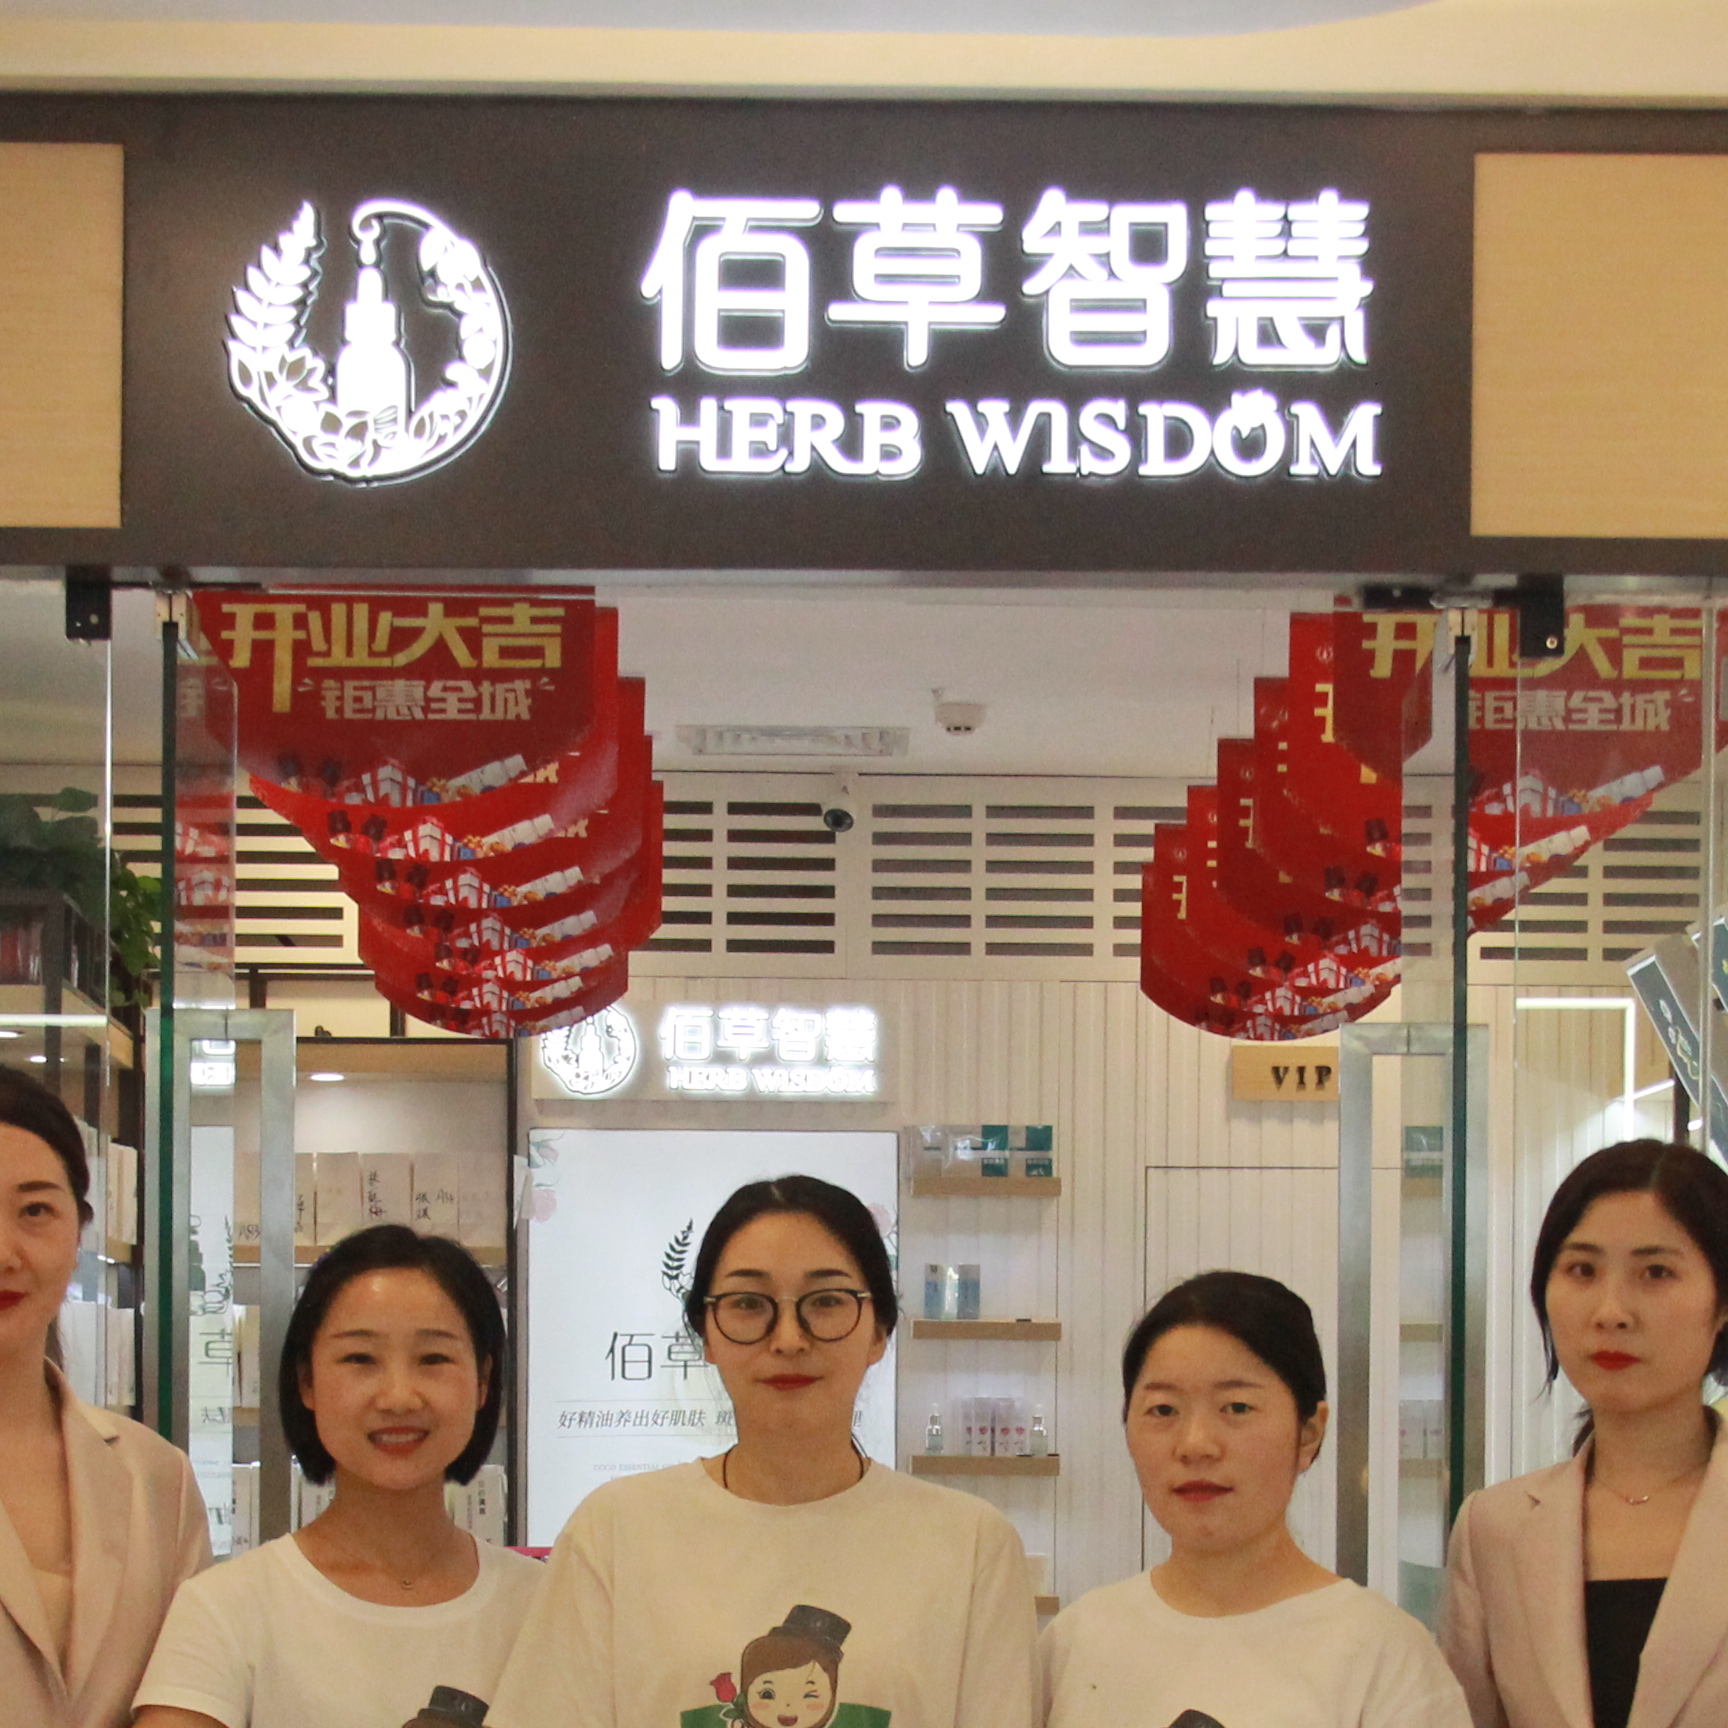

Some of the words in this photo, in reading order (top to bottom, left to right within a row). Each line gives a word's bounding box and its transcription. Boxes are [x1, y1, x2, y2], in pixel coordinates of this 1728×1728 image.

[640, 186, 1374, 374] 佰草智慧
[651, 398, 923, 478] HERB
[946, 390, 1383, 478] WISDOM
[220, 601, 566, 713] 开业大吉
[320, 678, 532, 721] 钜惠全城
[659, 1005, 877, 1063] 佰草智慧
[667, 1066, 747, 1093] HERB
[752, 1063, 877, 1094] WISDOM
[1271, 1065, 1332, 1091] VIP
[557, 1408, 706, 1430] 好精油养出好肌肤
